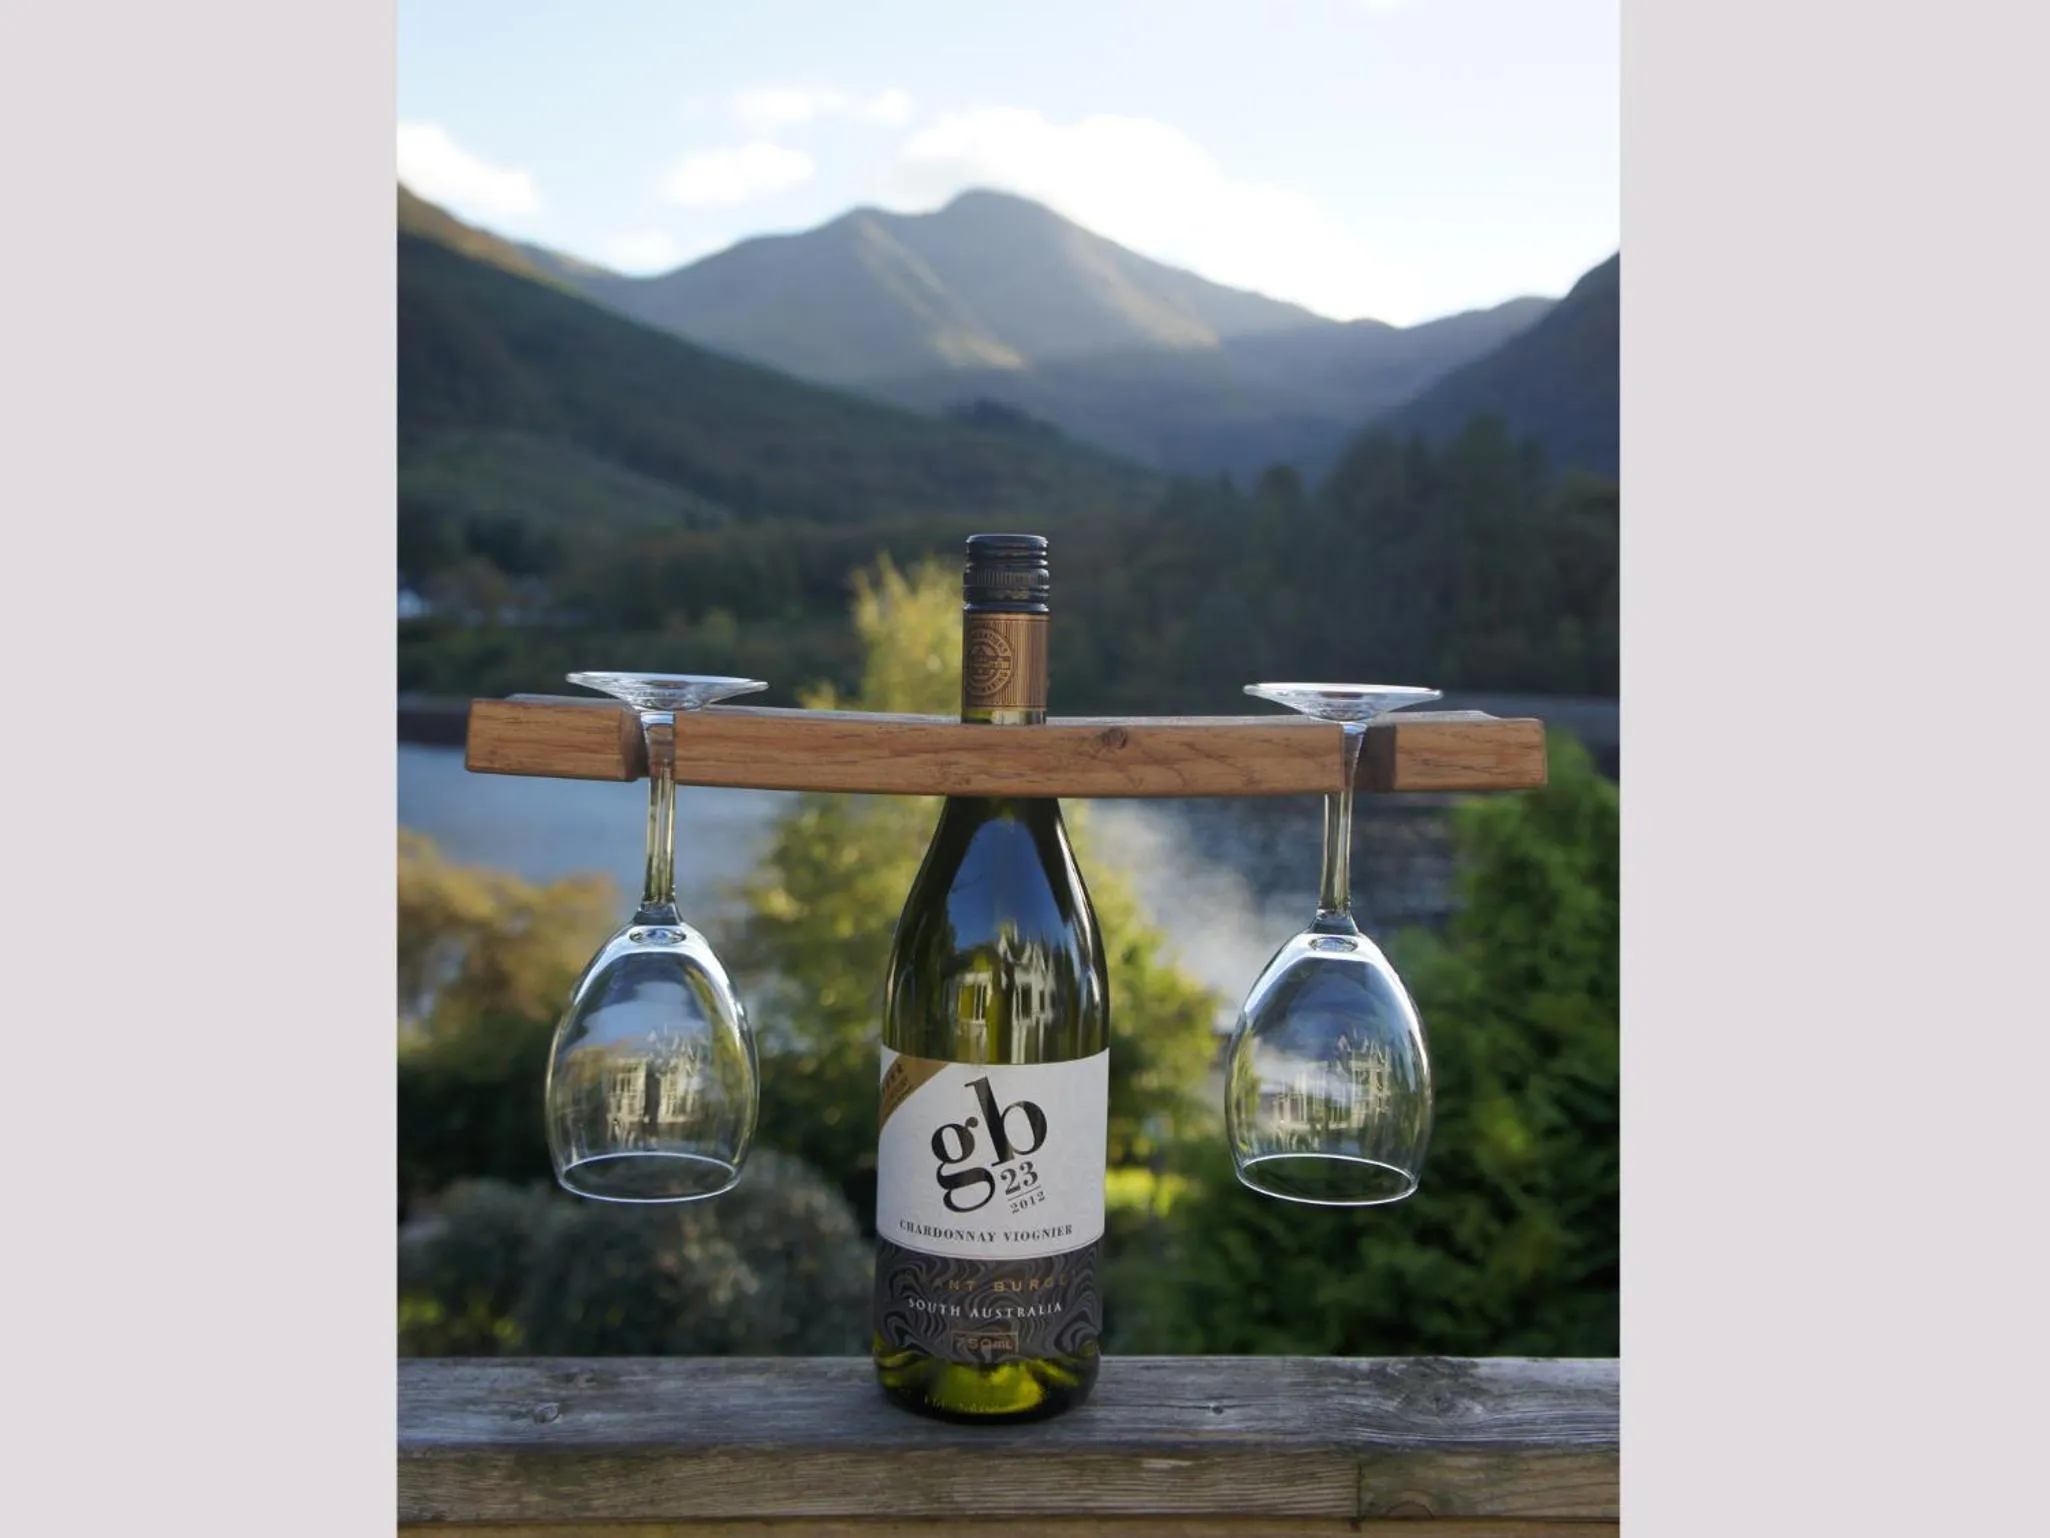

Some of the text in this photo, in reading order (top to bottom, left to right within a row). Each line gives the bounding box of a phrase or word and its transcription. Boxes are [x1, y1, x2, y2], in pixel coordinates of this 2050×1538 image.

[931, 1076, 1048, 1213] gb
[1001, 1161, 1039, 1195] 23
[1010, 1191, 1046, 1214] 2012
[899, 1220, 1073, 1243] CHARDONNAY VIOGNIER
[908, 1298, 1063, 1320] SOUTH AUSTRALIA
